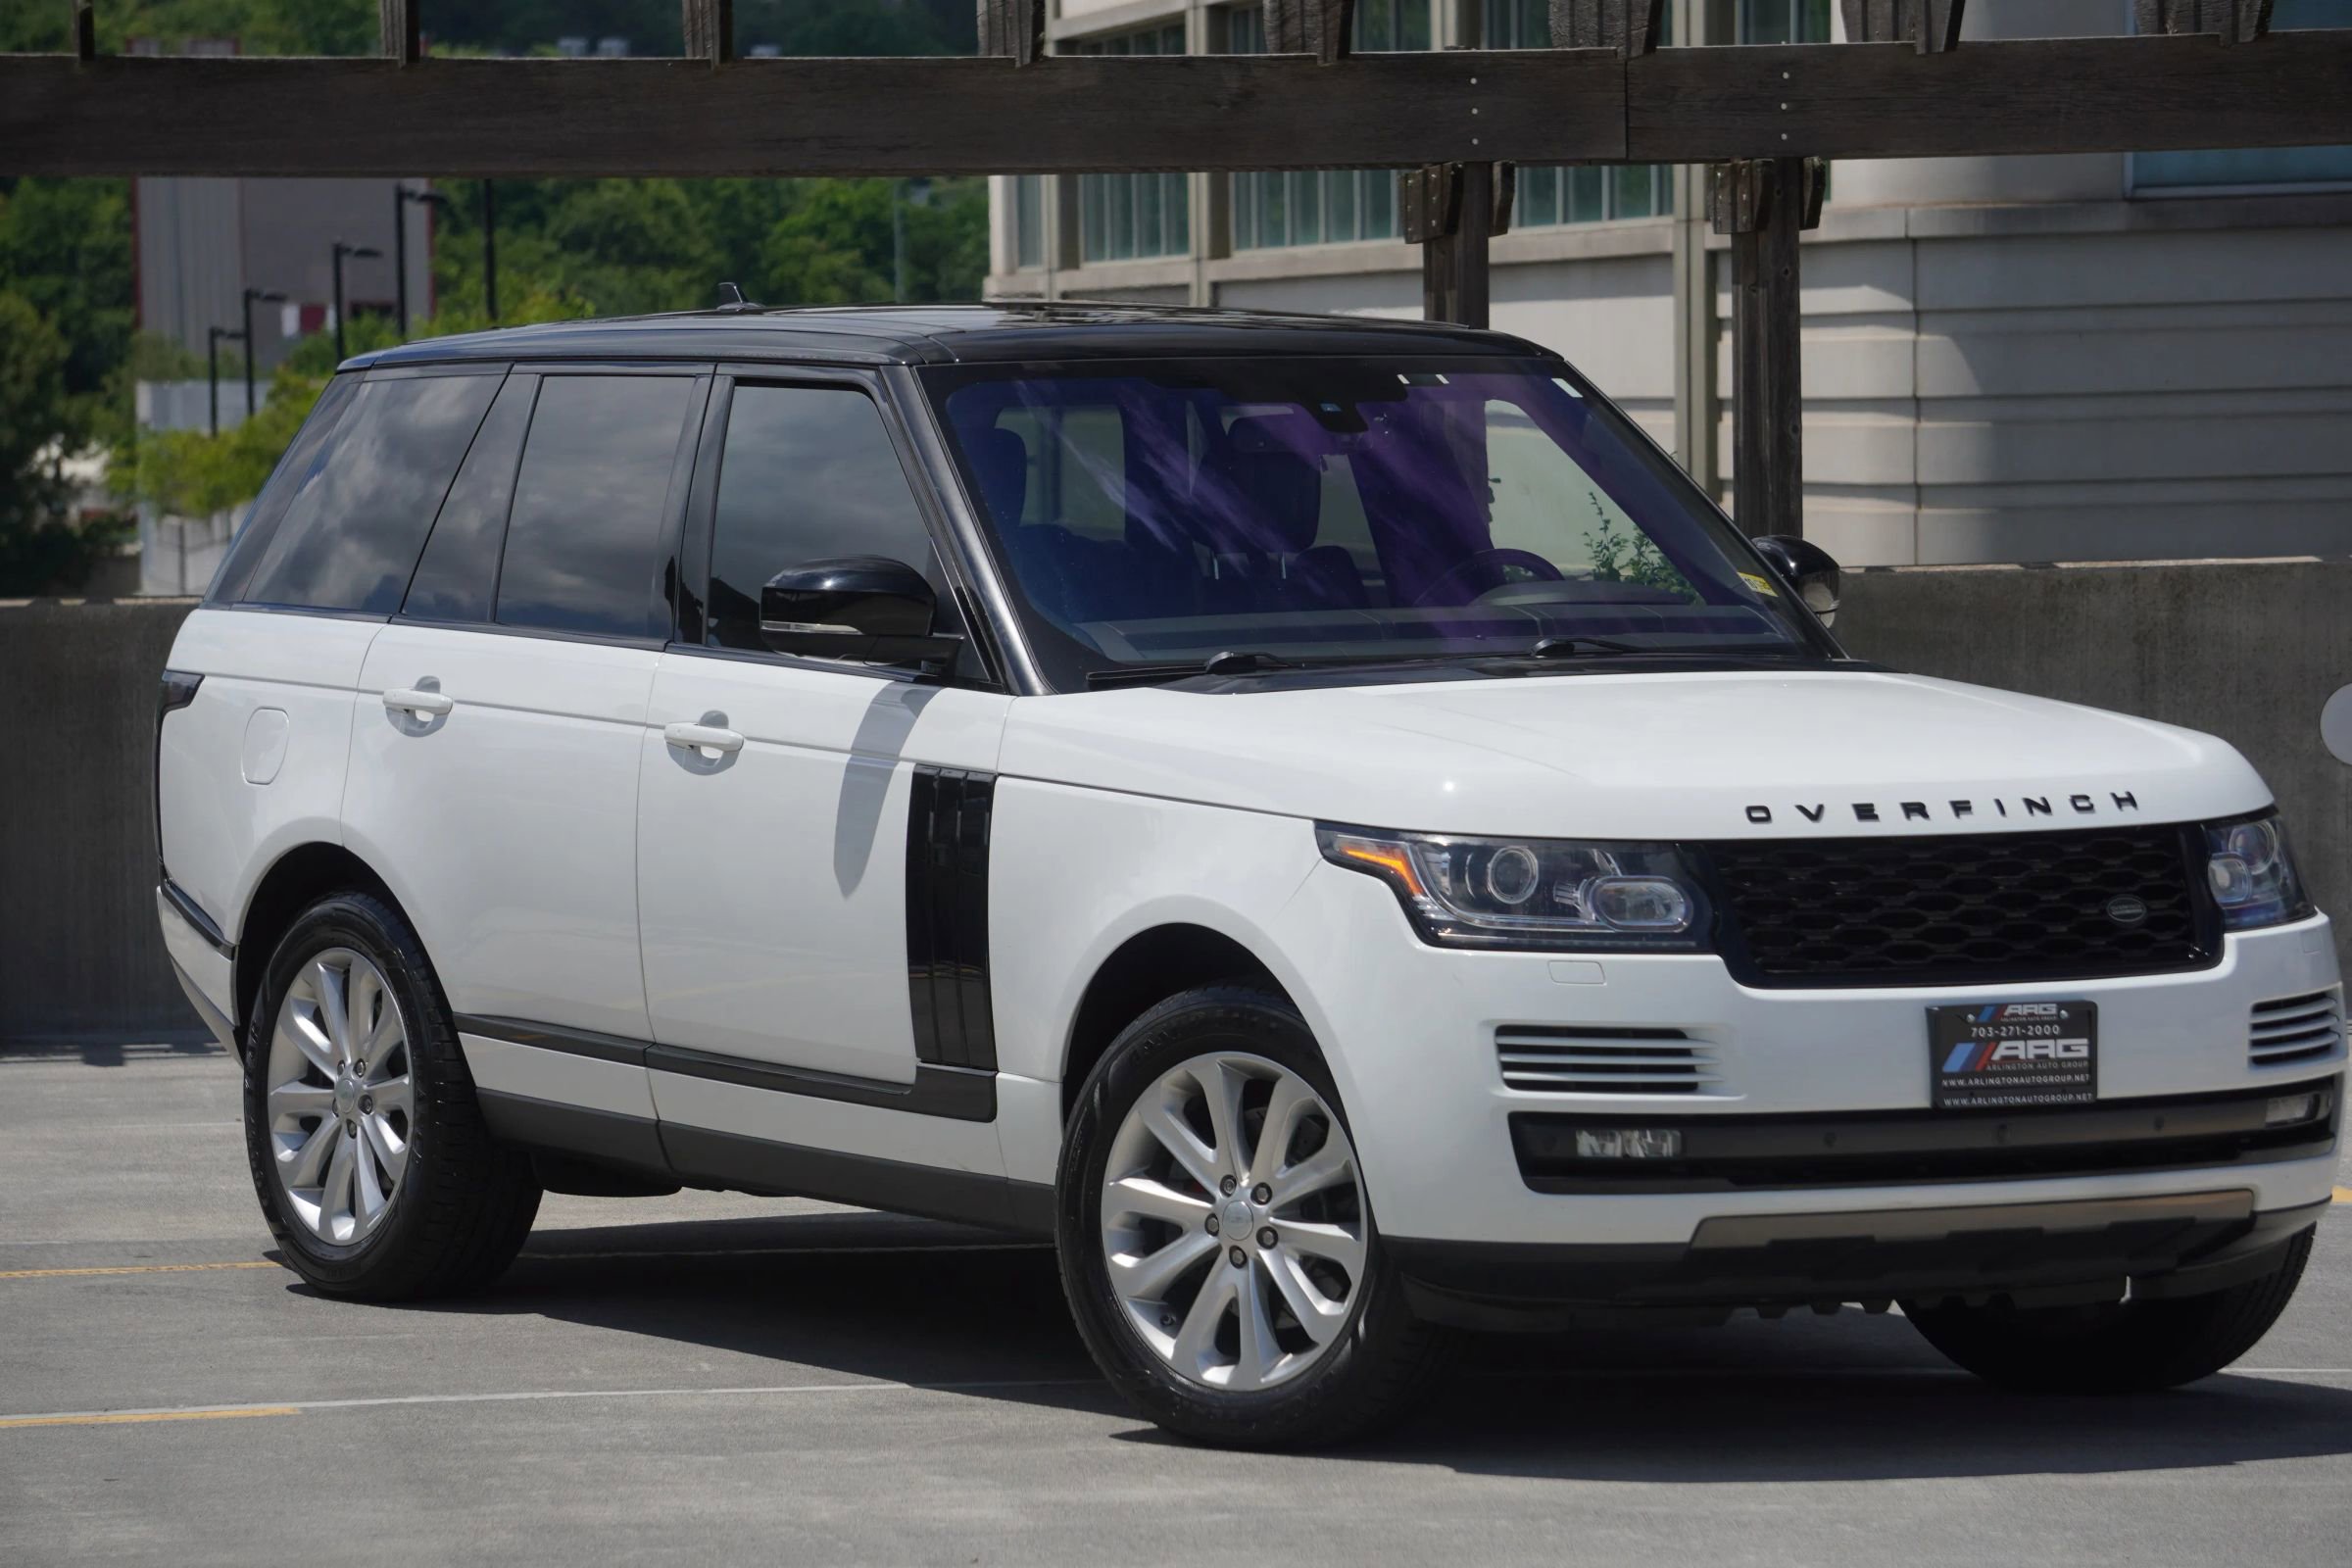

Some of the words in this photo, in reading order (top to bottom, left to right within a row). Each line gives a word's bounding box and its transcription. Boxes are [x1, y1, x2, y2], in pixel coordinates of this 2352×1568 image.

[1744, 791, 2139, 823] OVERFINCH
[2003, 1004, 2057, 1016] AAG
[1971, 1024, 2061, 1038] 703-271-2000
[1990, 1038, 2089, 1060] AAG
[1986, 1063, 2034, 1072] ARLINGTON
[2036, 1061, 2059, 1070] AUTO
[1943, 1093, 2093, 1106] WWW.ARLINGTONAUTOGROUP.NET
